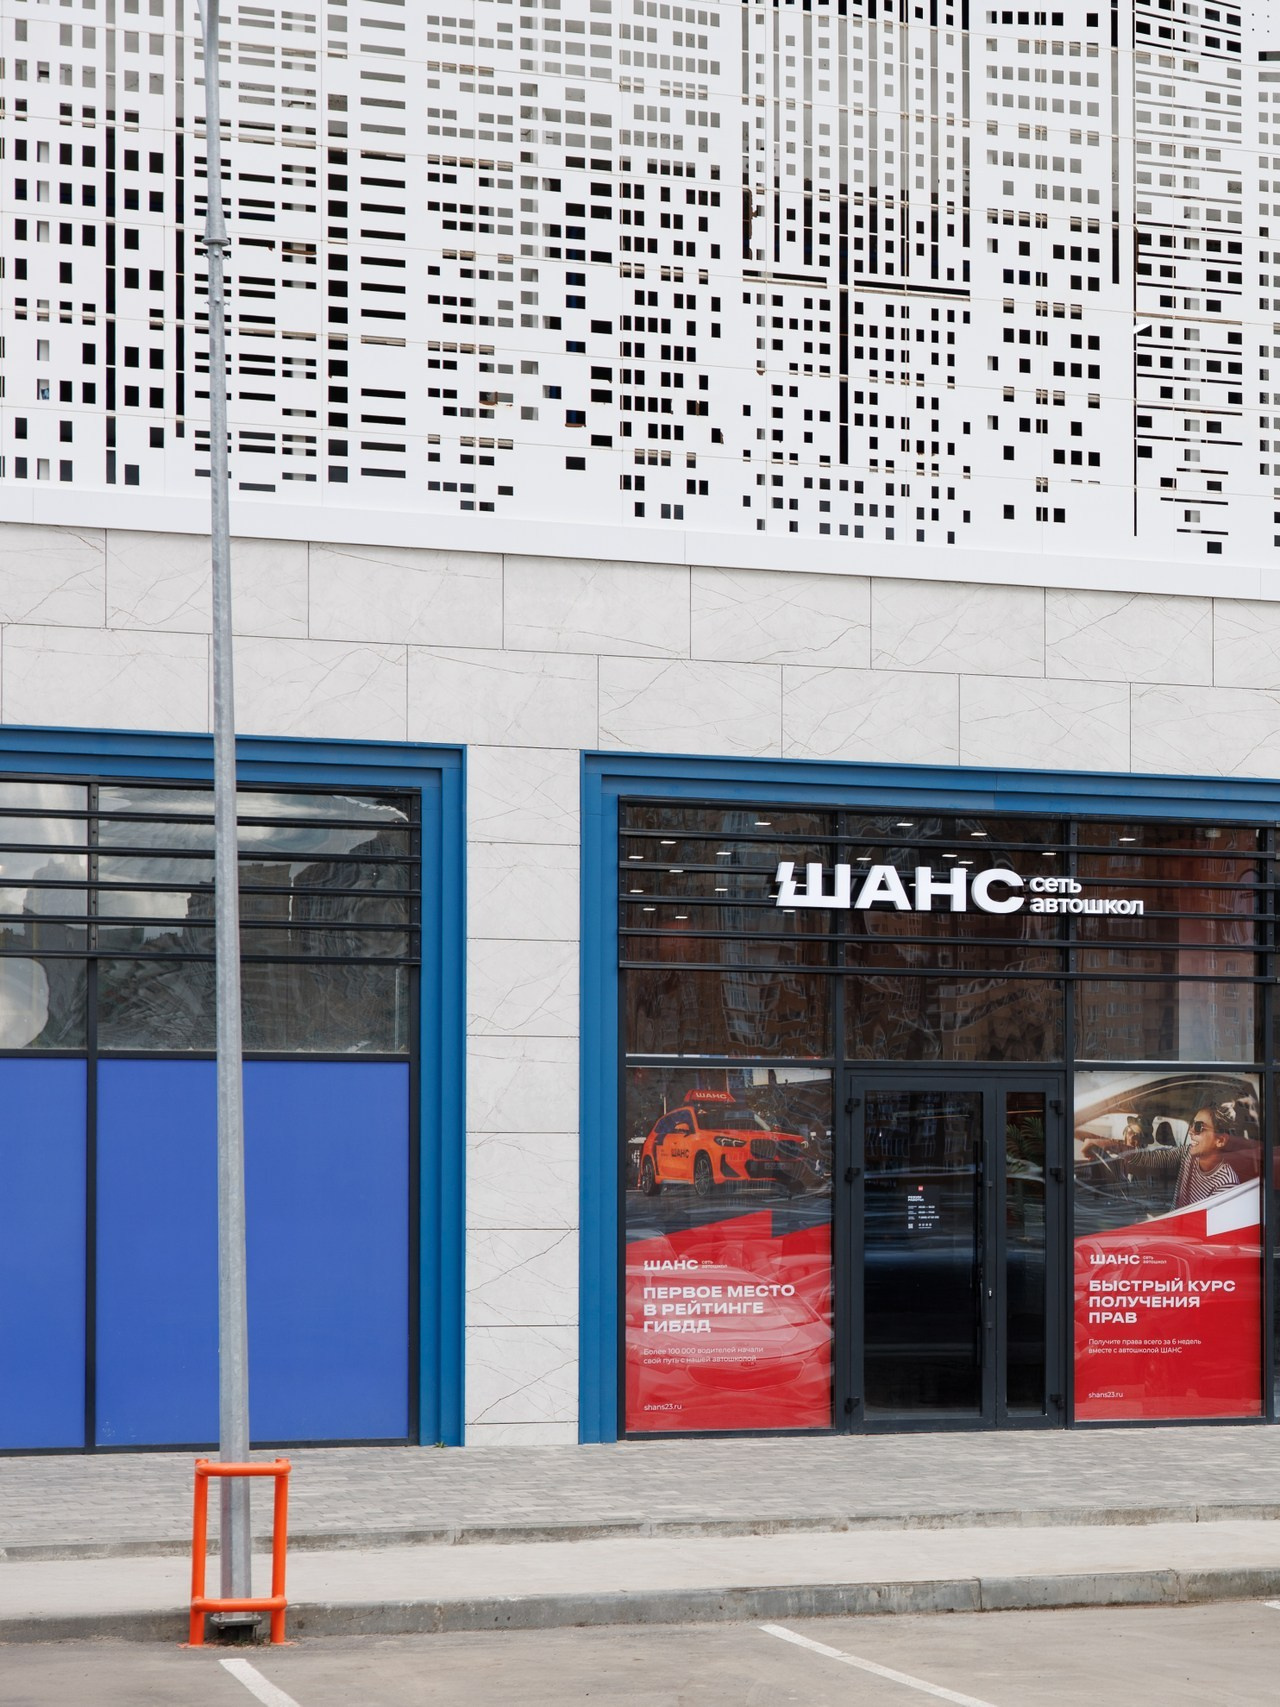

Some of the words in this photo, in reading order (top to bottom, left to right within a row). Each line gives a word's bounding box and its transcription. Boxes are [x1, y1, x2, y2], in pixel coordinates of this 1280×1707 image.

[775, 861, 1025, 914] ШАНС
[1029, 877, 1083, 894] сеть
[1029, 898, 1144, 915] автошкол
[644, 1260, 699, 1271] ШАНС
[1090, 1254, 1140, 1265] ШАНС
[1089, 1278, 1184, 1292] БЫСТРЫЙ
[1187, 1280, 1236, 1292] КУРС
[644, 1286, 722, 1299] ПЕРВОЕ
[727, 1285, 795, 1297] МЕСТО
[644, 1304, 657, 1316] В
[662, 1300, 764, 1315] РЕЙТИНГЕ
[1088, 1296, 1200, 1308] ПОЛУЧЕНИЯ
[1088, 1312, 1137, 1323] ПРАВ
[644, 1320, 711, 1333] ГИБДД
[644, 1403, 682, 1411] shans23.ru
